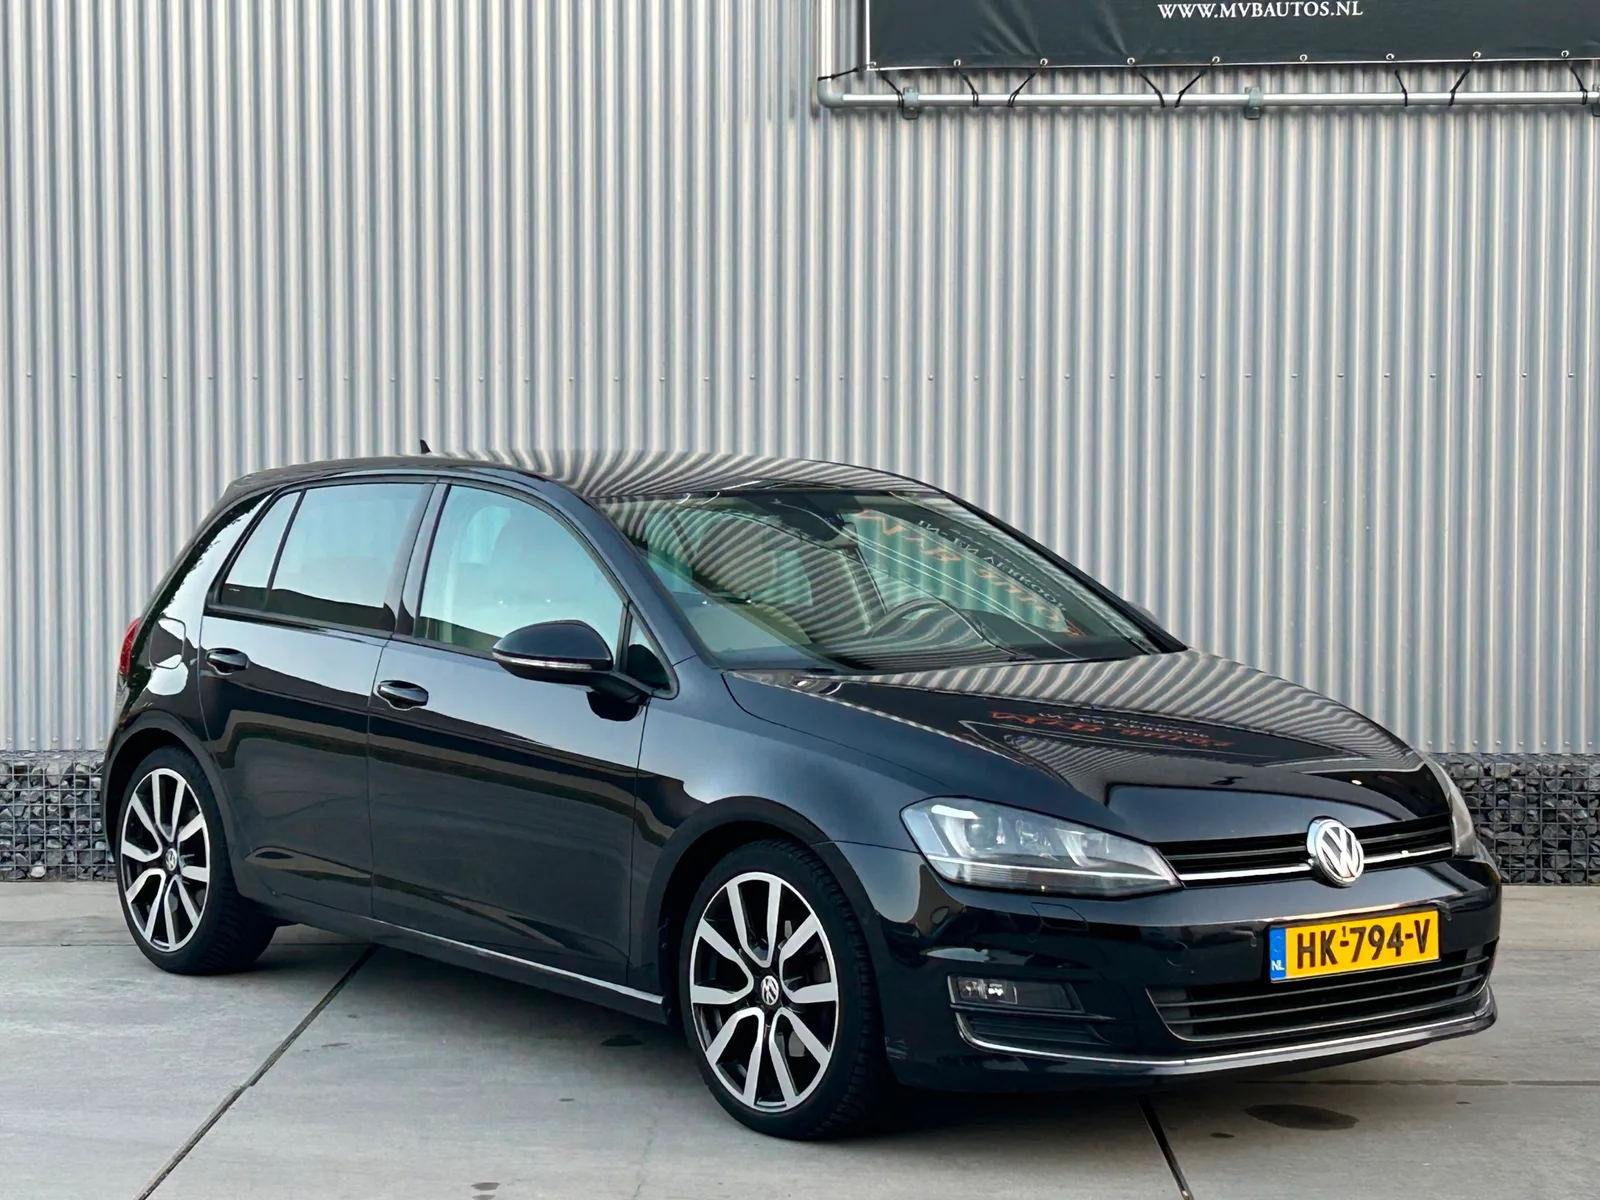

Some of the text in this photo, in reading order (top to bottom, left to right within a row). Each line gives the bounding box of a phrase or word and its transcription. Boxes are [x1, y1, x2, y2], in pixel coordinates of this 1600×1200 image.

[1157, 1, 1363, 19] WWW.MVBAUTOS.NL
[1314, 819, 1364, 886] VW
[1297, 918, 1431, 969] HK-794-V
[1271, 960, 1285, 971] NL
